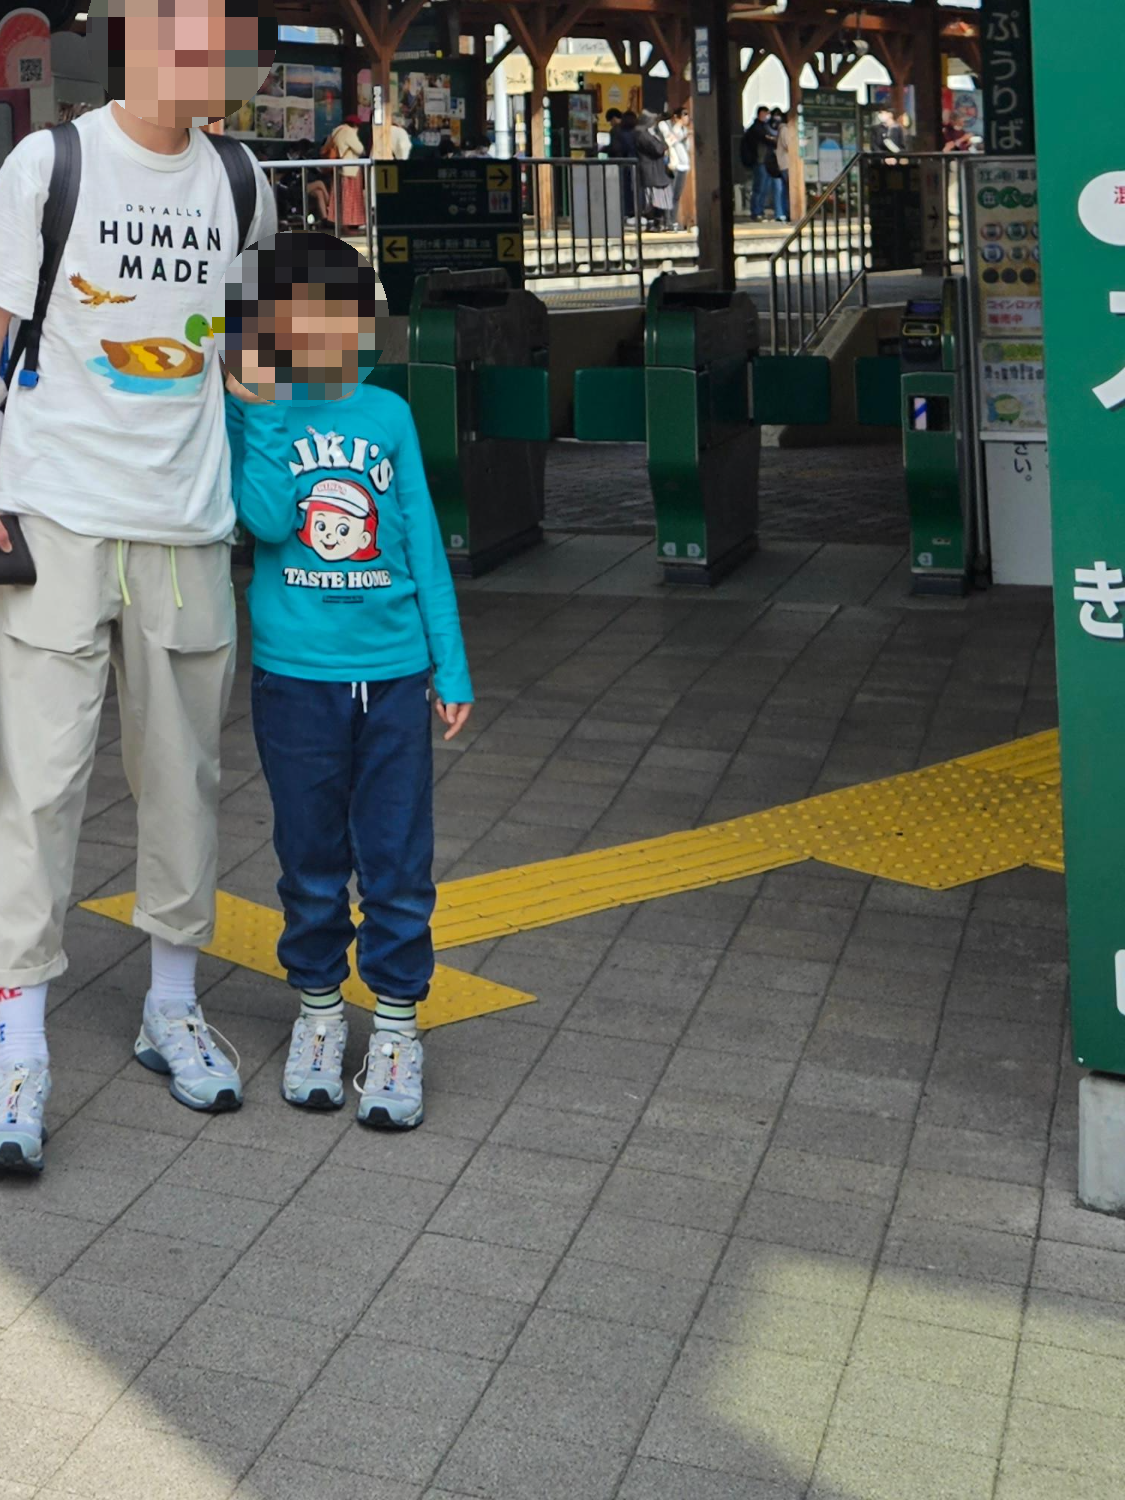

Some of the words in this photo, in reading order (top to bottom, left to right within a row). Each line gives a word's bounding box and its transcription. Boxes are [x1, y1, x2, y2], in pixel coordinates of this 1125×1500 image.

[382, 169, 389, 189] 1
[125, 203, 202, 218] DRYALLS
[99, 220, 222, 252] HUMAN
[503, 237, 515, 258] 2
[118, 254, 209, 285] MADE
[283, 566, 345, 588] TASTE
[347, 569, 392, 590] HOME
